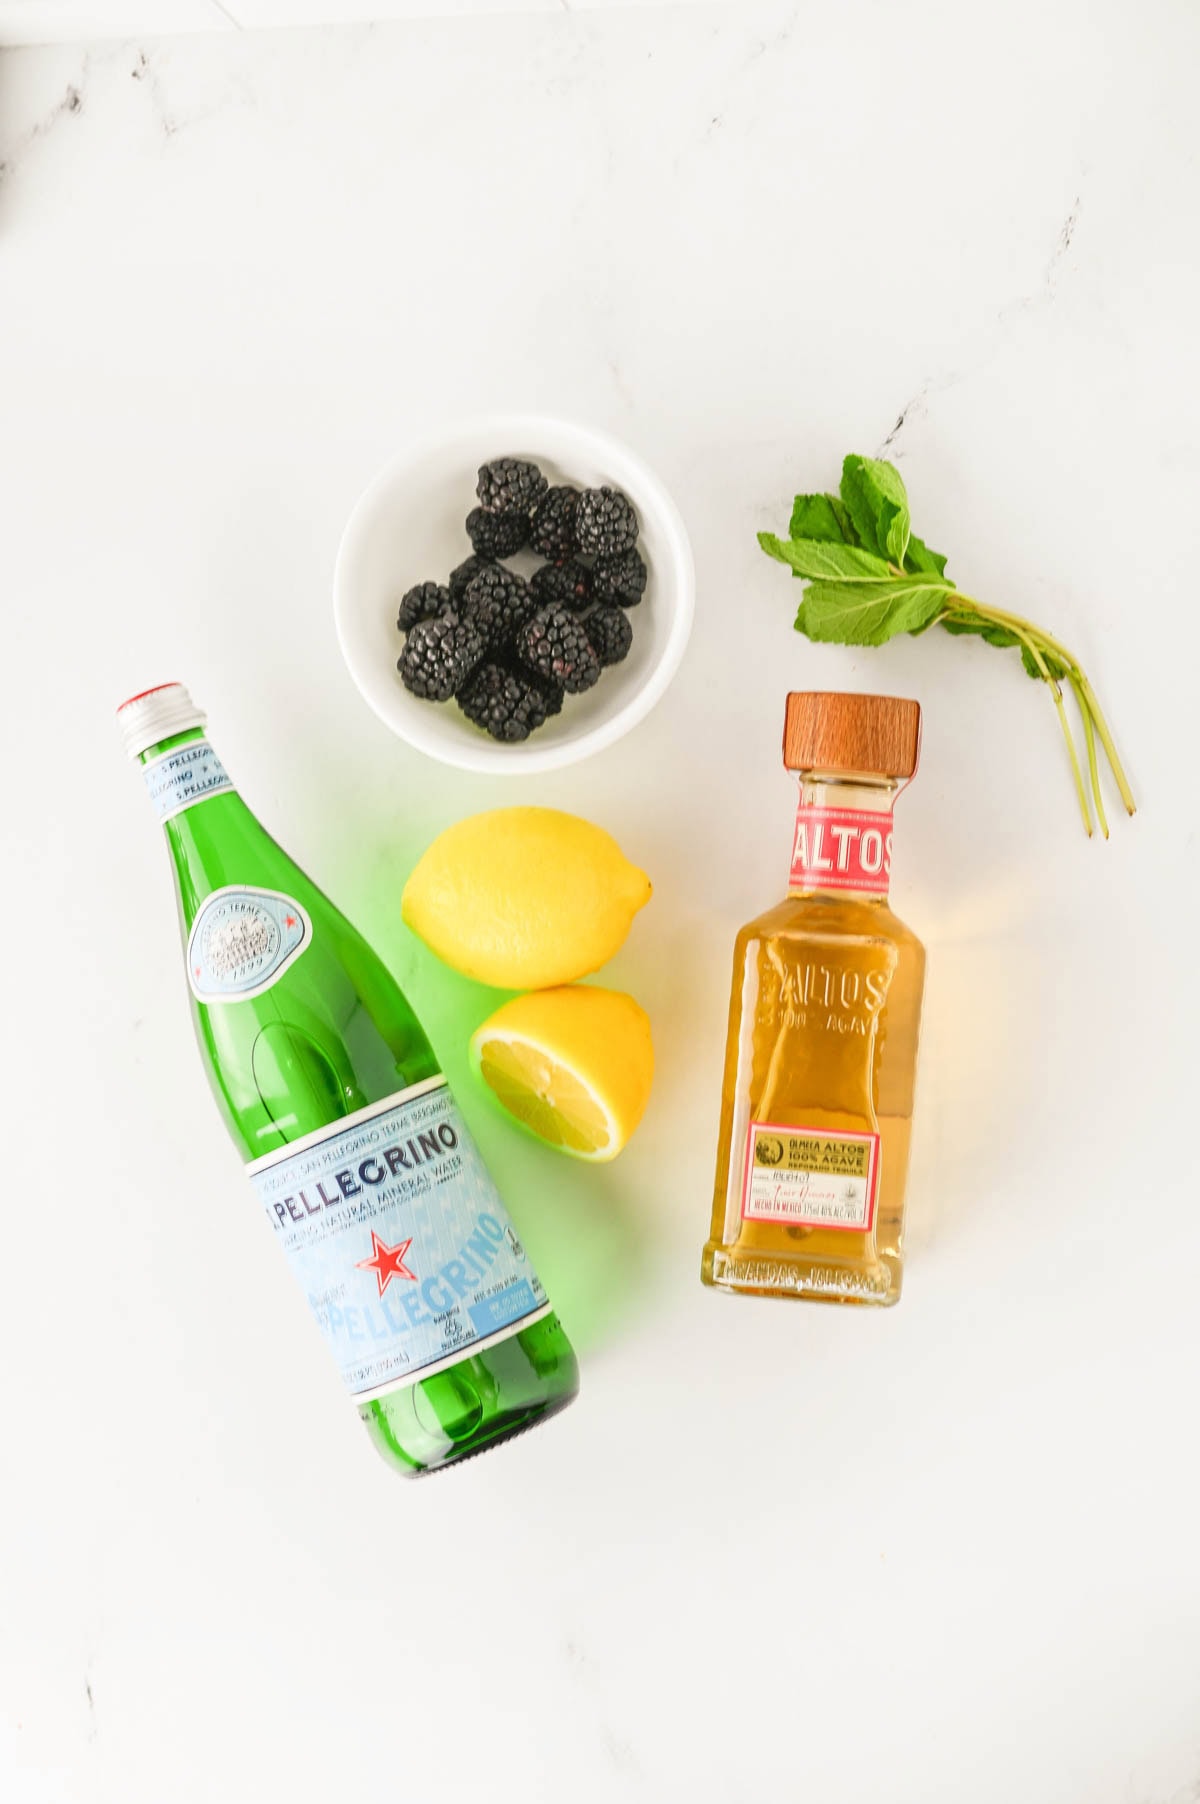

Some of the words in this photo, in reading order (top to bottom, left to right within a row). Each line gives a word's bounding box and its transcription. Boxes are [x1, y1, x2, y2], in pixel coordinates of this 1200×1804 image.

[230, 903, 260, 915] TERME
[779, 963, 885, 1011] ALTOS
[322, 1131, 380, 1167] PELLEGRINO
[824, 1142, 865, 1154] ALTOS
[789, 1151, 818, 1162] 100%
[822, 1154, 864, 1167] AGAVE
[788, 1162, 830, 1171] REPOSADO
[832, 1167, 863, 1175] TEQUILA
[377, 1172, 431, 1204] MINERAL
[432, 1155, 462, 1176] WATER
